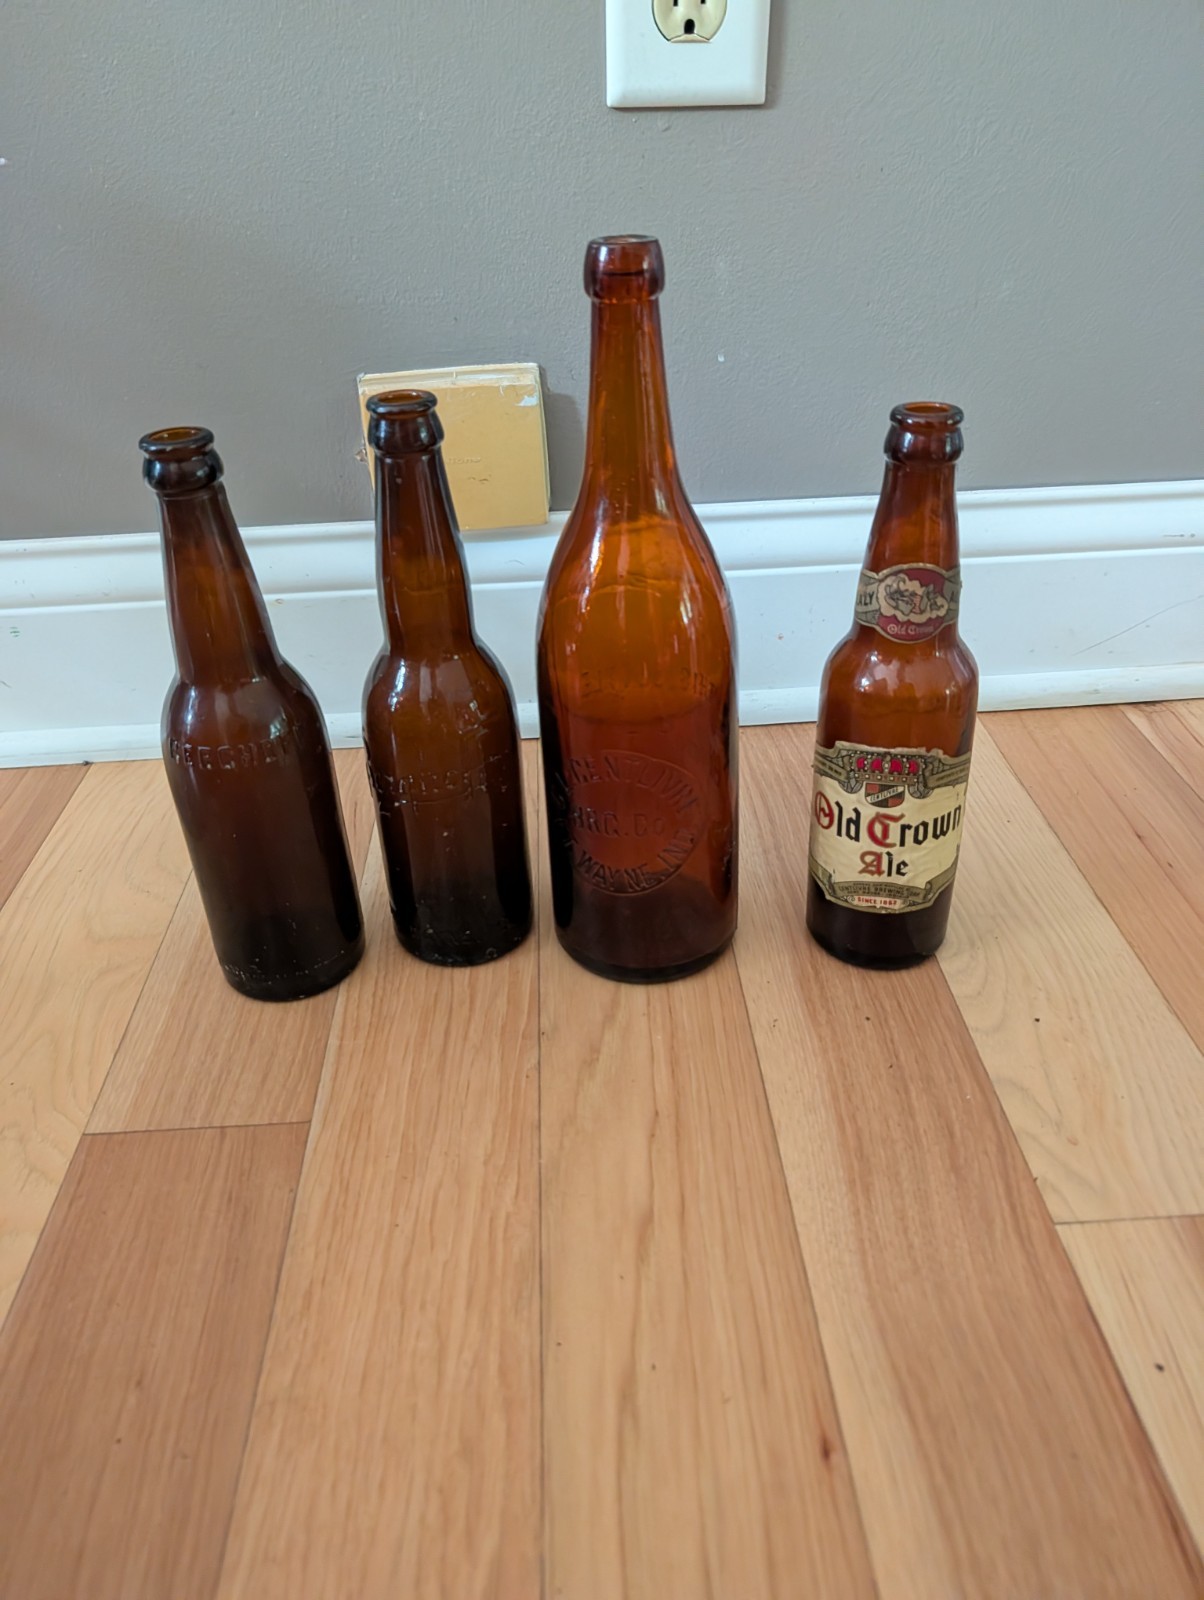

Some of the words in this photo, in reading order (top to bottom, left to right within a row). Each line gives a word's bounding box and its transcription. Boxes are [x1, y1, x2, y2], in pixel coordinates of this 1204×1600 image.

[887, 624, 906, 635] Old
[814, 791, 861, 842] Old
[867, 805, 962, 848] Crown
[858, 851, 909, 877] Ale
[857, 896, 877, 905] SINCE
